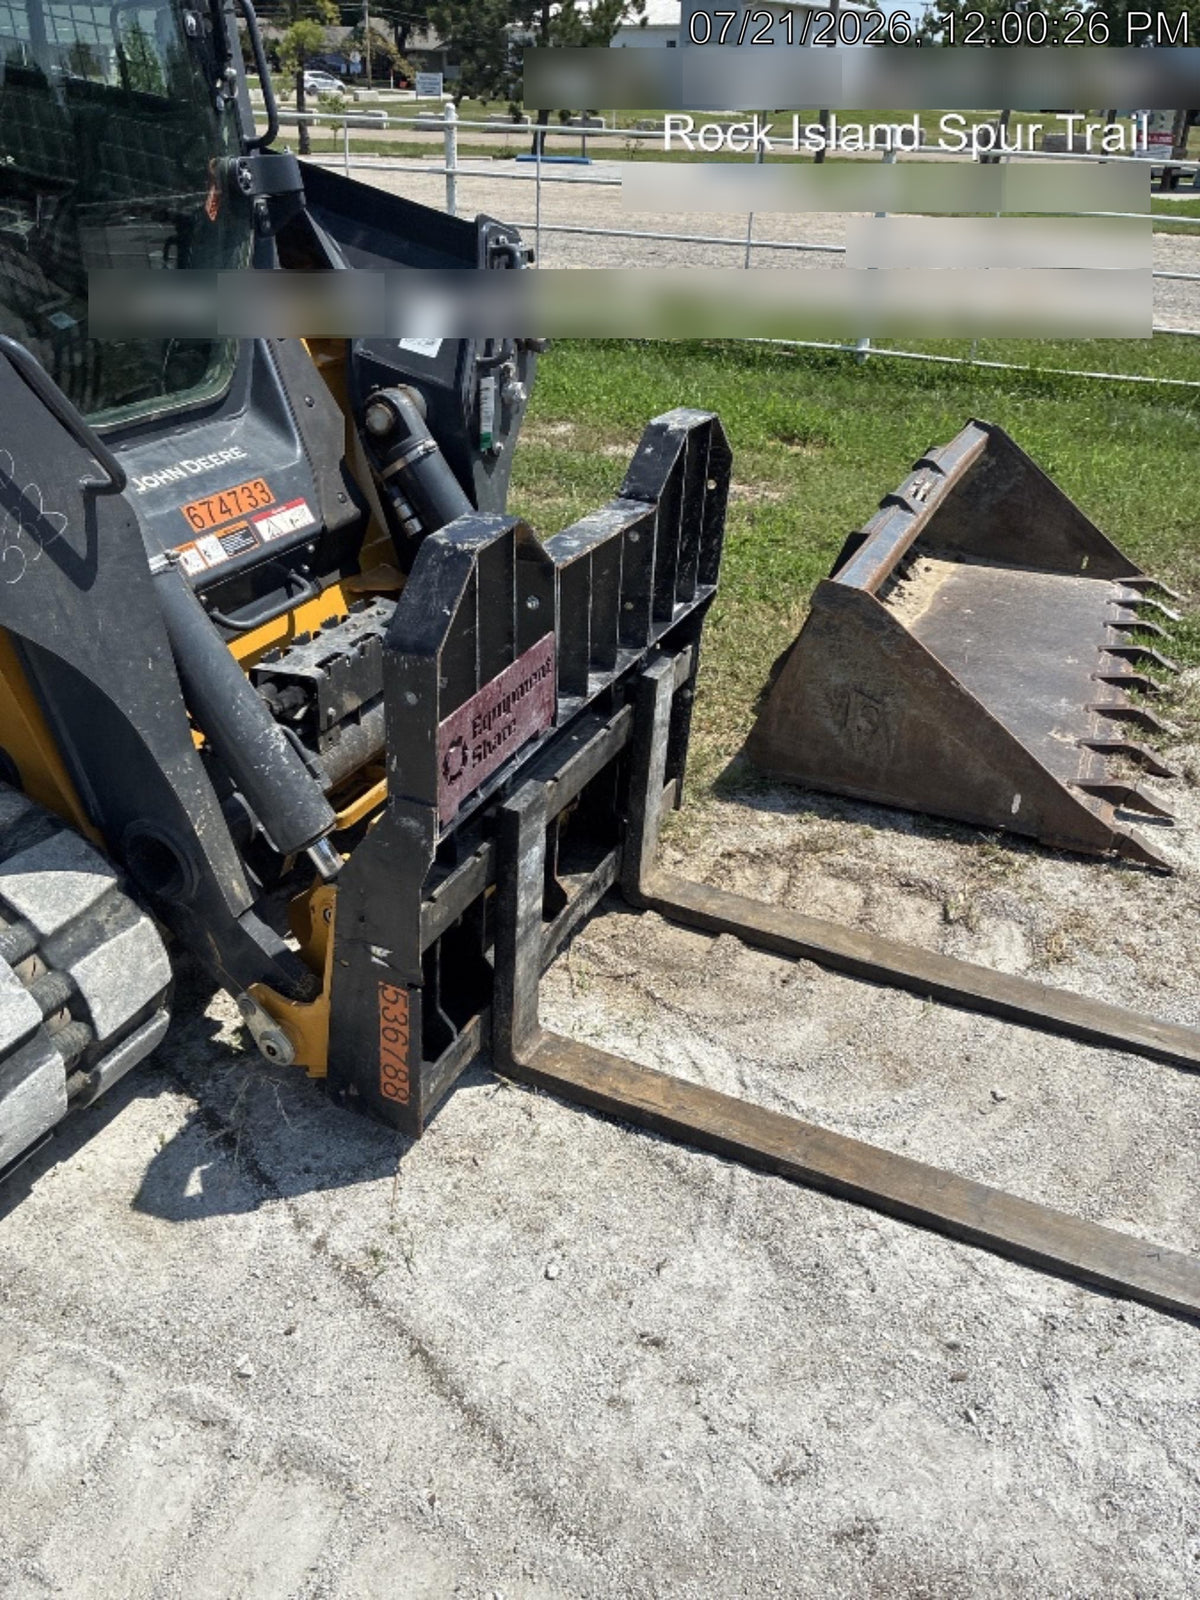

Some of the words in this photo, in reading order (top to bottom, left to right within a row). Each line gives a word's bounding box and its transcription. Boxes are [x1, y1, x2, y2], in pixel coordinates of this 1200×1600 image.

[131, 465, 188, 494] JOHN
[183, 446, 247, 474] DEERE
[186, 481, 272, 530] 674733
[471, 656, 553, 739] Equipment
[381, 985, 409, 1101] 536788
